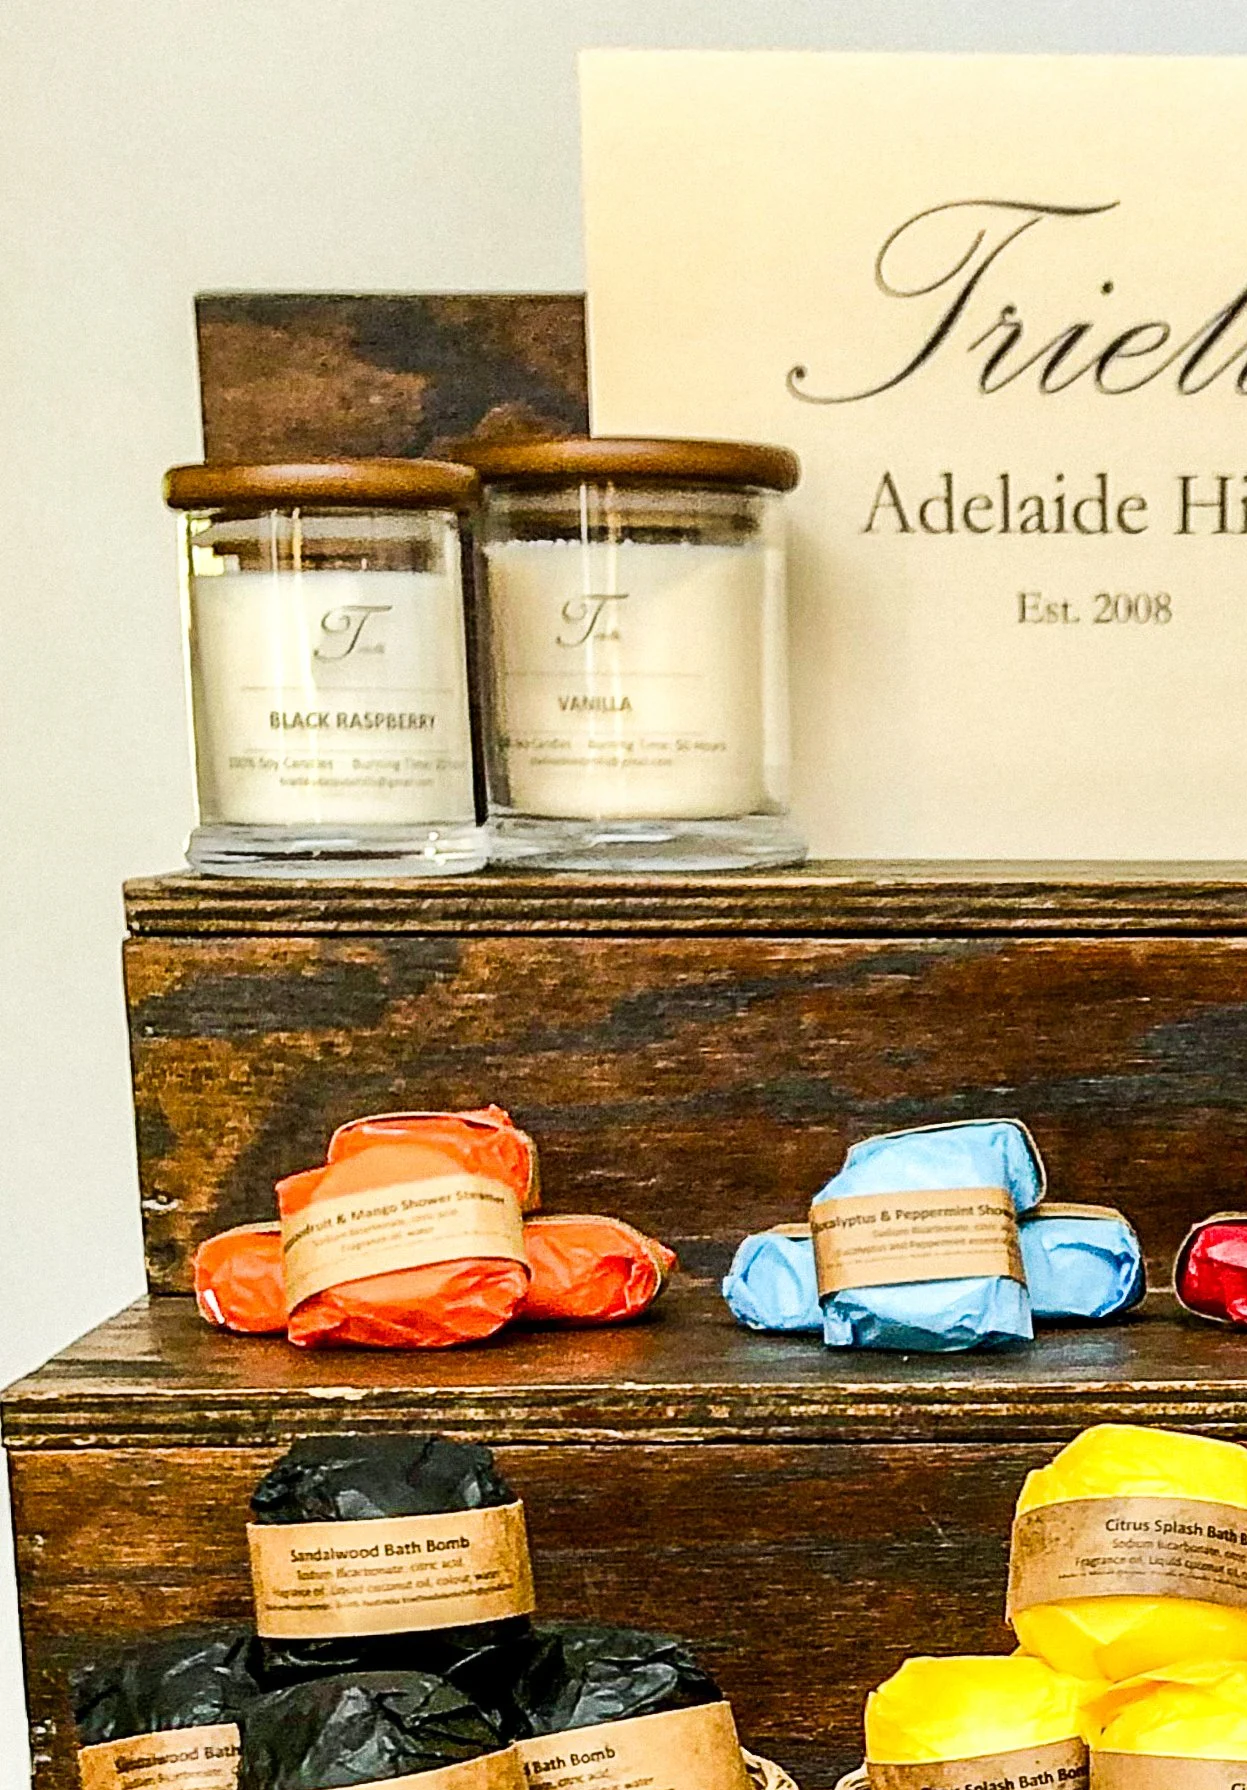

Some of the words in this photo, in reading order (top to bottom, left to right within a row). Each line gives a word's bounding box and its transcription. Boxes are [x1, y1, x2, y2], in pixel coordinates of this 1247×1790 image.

[863, 469, 1149, 537] Adelaide
[1017, 592, 1081, 624] Est.
[1094, 592, 1174, 624] 2008
[557, 696, 633, 713] VANILLA
[269, 711, 331, 729] BLACK
[336, 712, 437, 730] RASPBERRY
[337, 1213, 347, 1225] &
[401, 1195, 451, 1210] Shower
[880, 1210, 891, 1222] &
[895, 1205, 974, 1222] Peppermint
[1105, 1518, 1150, 1532] Citrus
[1154, 1520, 1203, 1536] Splash
[1206, 1525, 1238, 1544] Bath
[291, 1544, 379, 1562] Sandalwood
[384, 1541, 422, 1556] Bath
[426, 1536, 470, 1552] Bomb
[532, 1756, 566, 1774] Bath
[570, 1744, 616, 1766] Bomb
[1019, 1772, 1053, 1789] Bath
